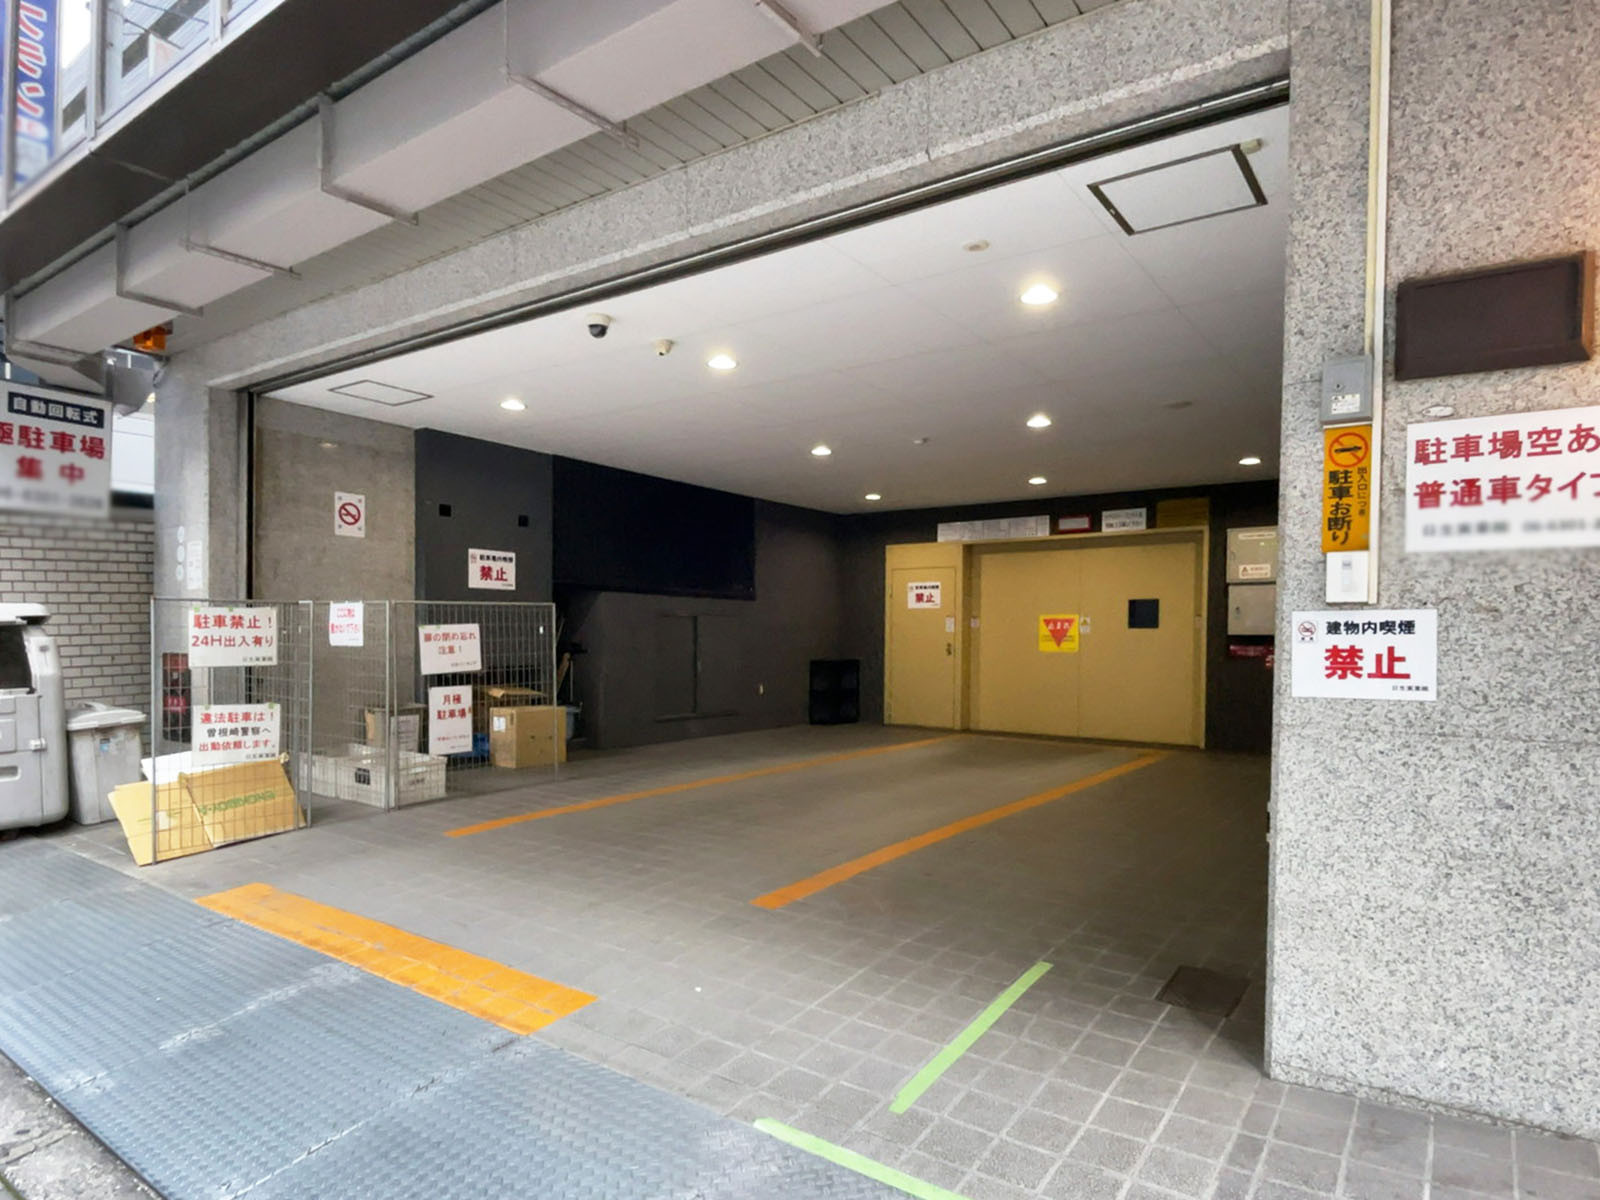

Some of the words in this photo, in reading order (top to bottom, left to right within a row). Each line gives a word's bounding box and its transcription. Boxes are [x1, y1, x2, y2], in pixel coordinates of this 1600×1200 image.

[13, 397, 98, 424] 自動回転式
[1328, 469, 1354, 545] 駐車お断り
[480, 565, 508, 582] 禁止
[1326, 620, 1416, 635] 建物内喫煙
[191, 634, 273, 648] 24H出入有り
[1324, 645, 1411, 680] 禁止
